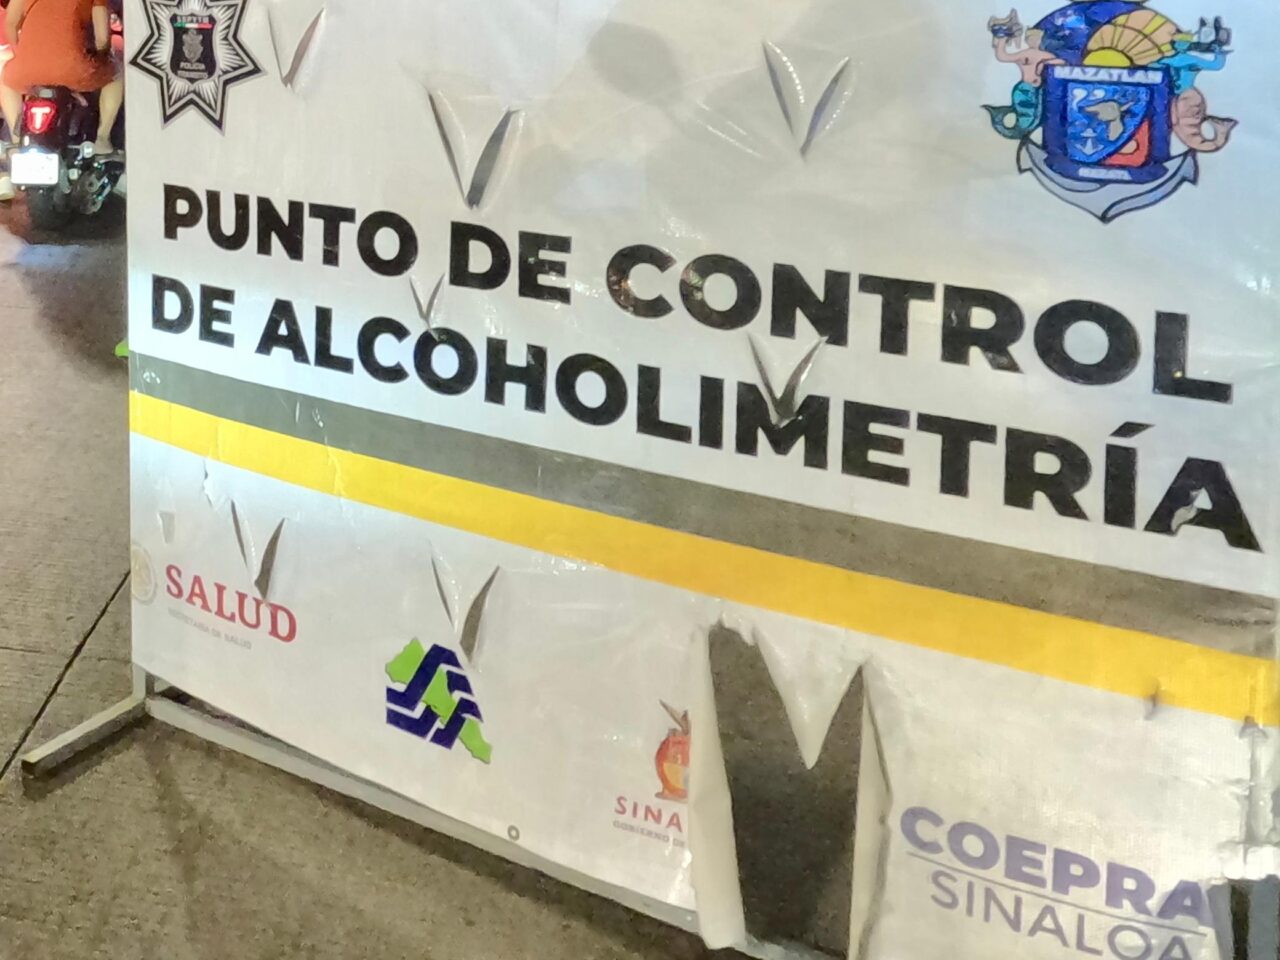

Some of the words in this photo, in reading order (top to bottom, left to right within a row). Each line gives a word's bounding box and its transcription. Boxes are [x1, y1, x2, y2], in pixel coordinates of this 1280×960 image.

[163, 183, 418, 276] PUNTO
[449, 221, 572, 305] DE
[606, 244, 1233, 404] CONTROL
[152, 273, 235, 348] DE
[255, 298, 1264, 553] ALCOHOLIMETRÍA
[165, 563, 297, 643] SALUD
[900, 806, 1216, 927] COEPRA
[930, 870, 1192, 960] SINALOA
